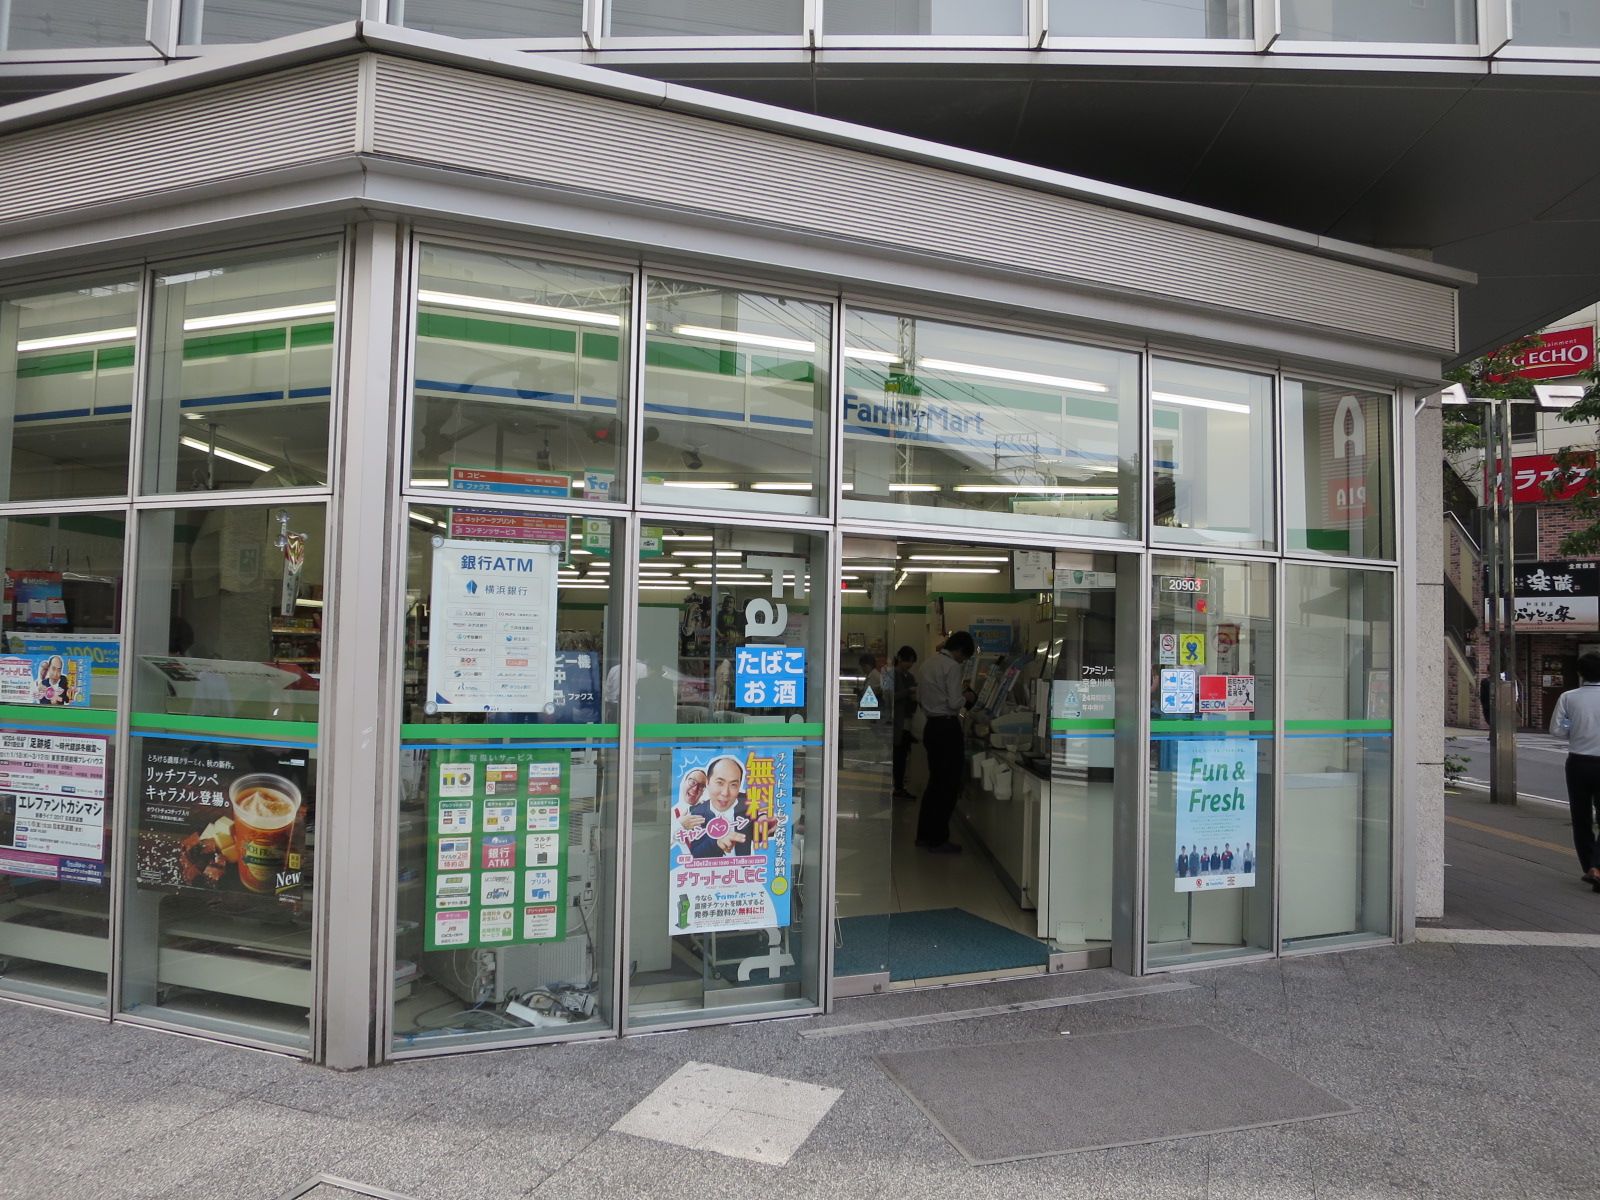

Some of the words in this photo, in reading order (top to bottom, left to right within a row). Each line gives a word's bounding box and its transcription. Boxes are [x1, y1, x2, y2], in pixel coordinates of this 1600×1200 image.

[1529, 345, 1588, 364] ECHO
[464, 516, 516, 525] ネットワークプリント
[461, 554, 533, 572] 銀行ATM
[485, 585, 528, 596] 横浜銀行
[1169, 579, 1201, 591] 20903
[737, 651, 803, 675] たばこ
[1082, 666, 1115, 675] ファミリー
[567, 693, 594, 701] ファクス
[744, 680, 796, 704] お酒
[1201, 700, 1225, 709] SECOM
[146, 767, 220, 787] リッチフラッペ
[1190, 758, 1228, 782] Fun
[1232, 761, 1246, 781] &
[145, 785, 230, 808] キャラメル登場。
[1189, 787, 1246, 813] Fresh
[18, 796, 103, 817] エレファントカシマシ
[487, 848, 511, 858] 銀行
[488, 860, 510, 868] ATM
[275, 872, 302, 888] New
